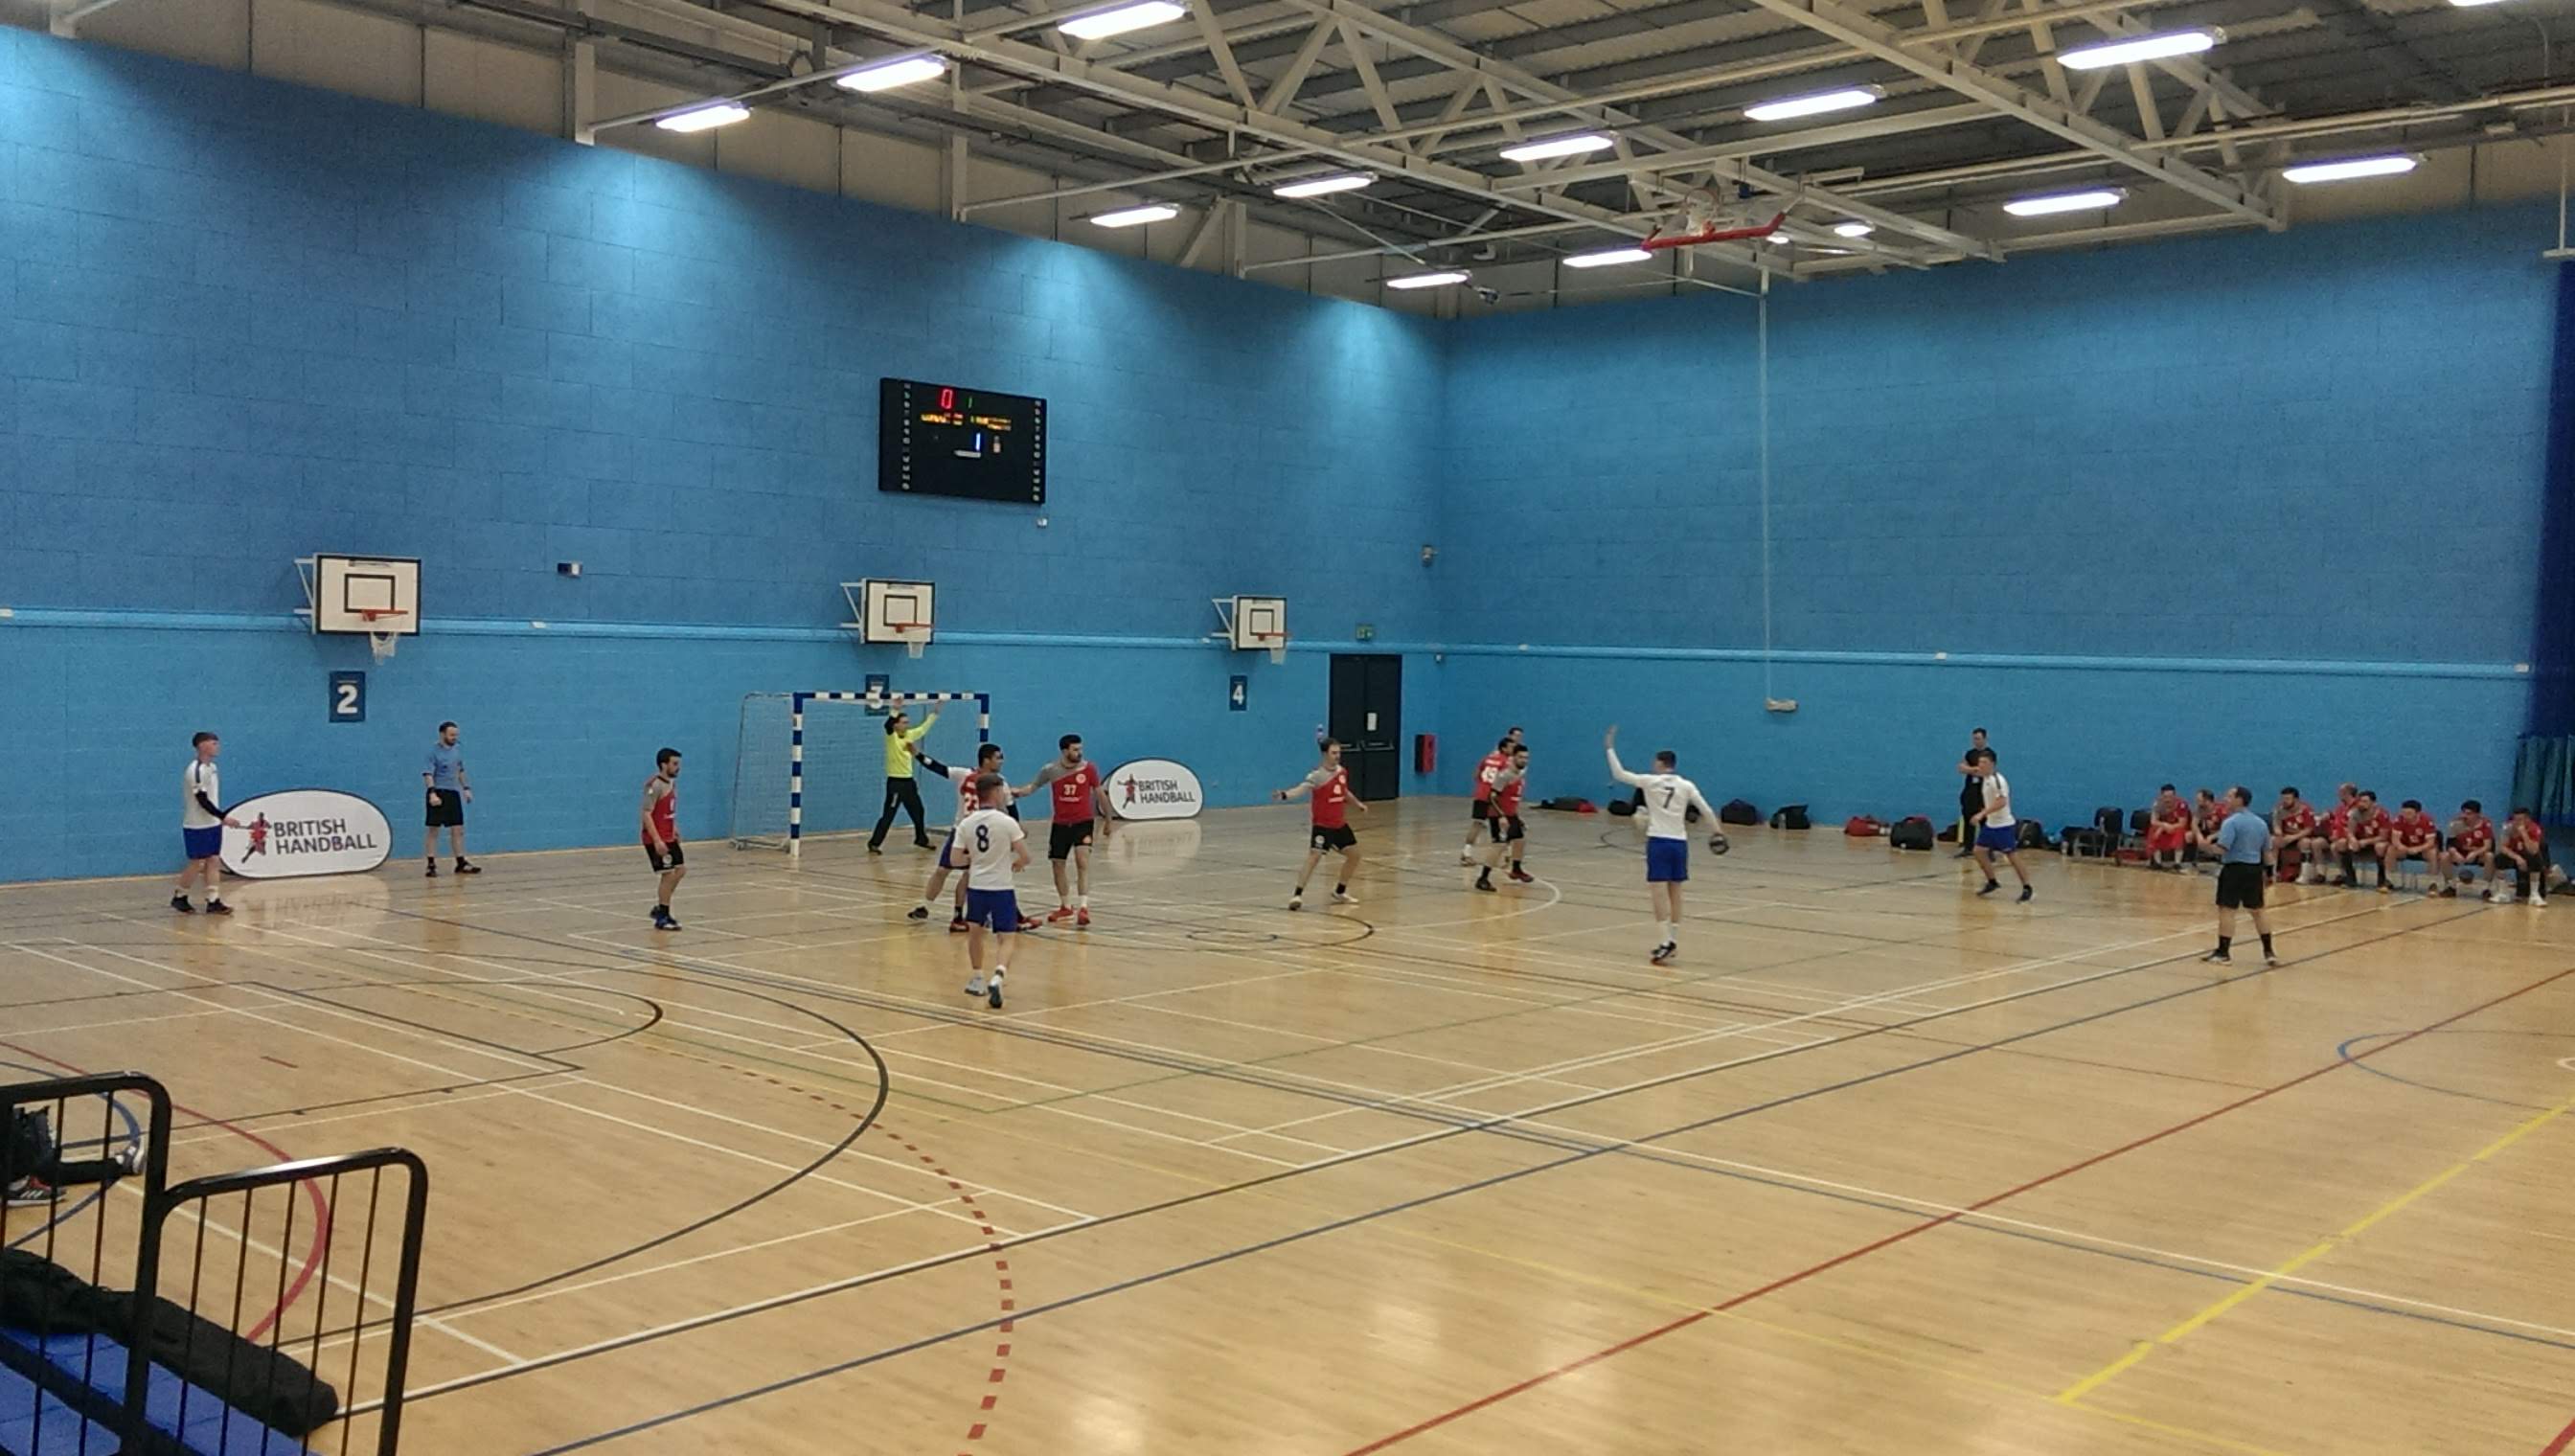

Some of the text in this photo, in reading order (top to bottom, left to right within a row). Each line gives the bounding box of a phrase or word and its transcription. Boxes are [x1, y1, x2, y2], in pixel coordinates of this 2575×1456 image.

[942, 389, 953, 409] 0
[337, 685, 358, 714] 2
[1232, 684, 1244, 705] 4
[1138, 780, 1178, 791] BRITISH
[1141, 791, 1196, 804] HANDBALL
[1663, 786, 1675, 808] 7
[274, 819, 346, 837] BRITISH
[276, 833, 377, 854] HANDBALL
[975, 825, 990, 853] 8
